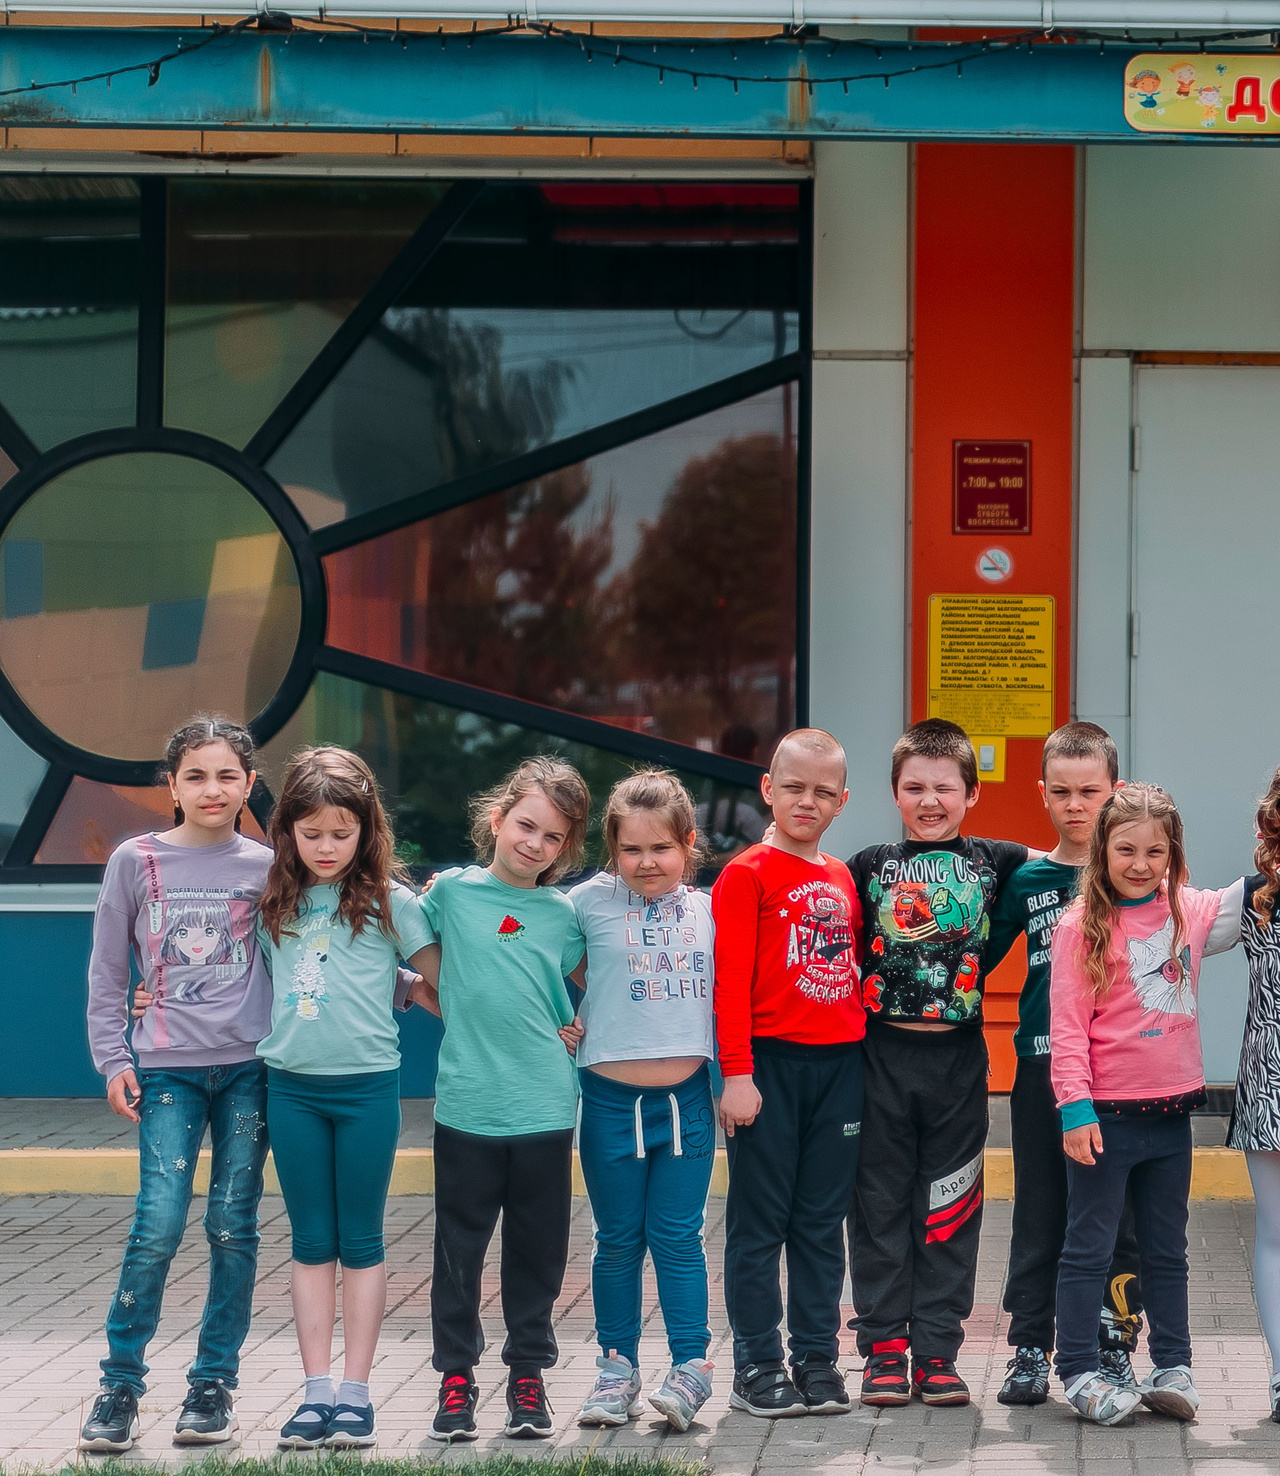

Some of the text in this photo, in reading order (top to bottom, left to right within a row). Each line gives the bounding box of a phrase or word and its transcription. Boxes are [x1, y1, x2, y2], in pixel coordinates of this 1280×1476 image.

[968, 476, 987, 488] 7:00
[999, 476, 1023, 488] 19:00
[967, 518, 1019, 526] ВОСКРЕСЕНЬЕ
[880, 856, 980, 884] AMONG US
[1027, 890, 1060, 913] BLUES
[625, 926, 696, 947] LET'S
[627, 951, 705, 975] MAKE
[630, 978, 707, 1002] SELFIE
